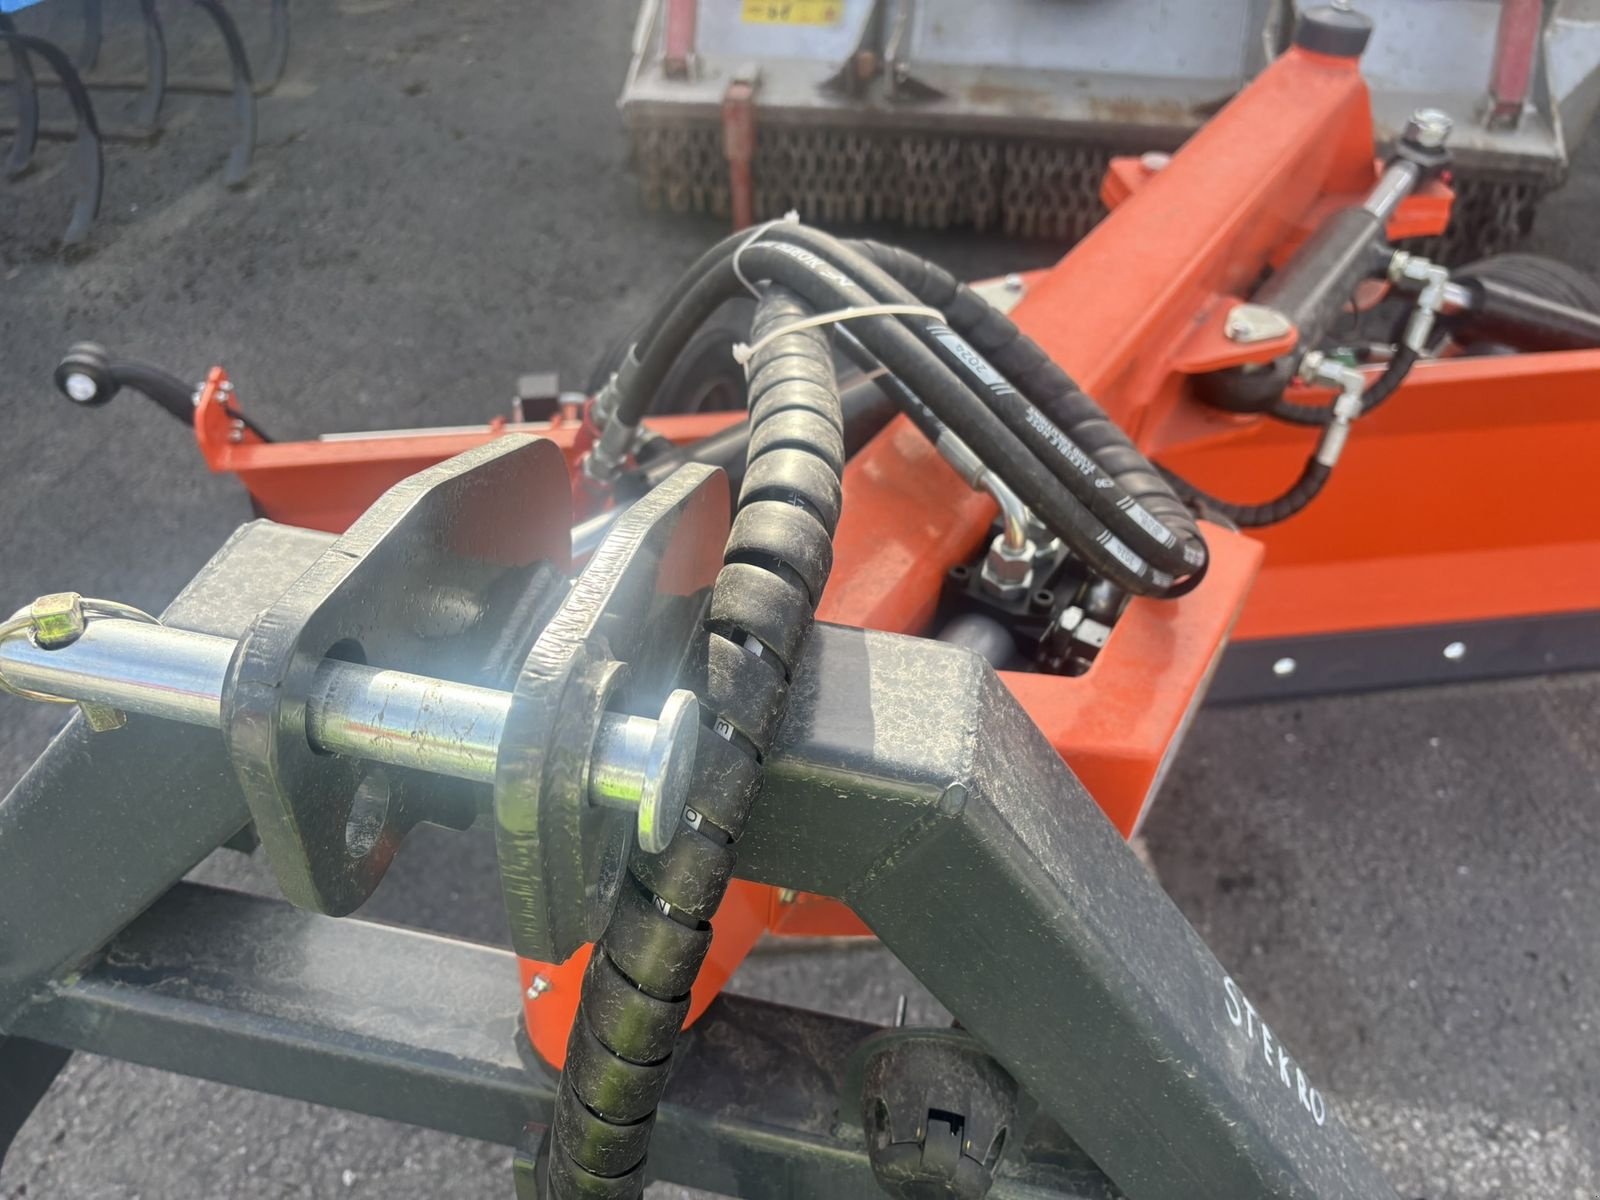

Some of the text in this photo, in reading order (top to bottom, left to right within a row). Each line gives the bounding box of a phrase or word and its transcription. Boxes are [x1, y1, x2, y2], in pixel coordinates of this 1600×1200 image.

[955, 343, 987, 374] 2024
[1025, 413, 1090, 475] FLEXIBLE HOSE
[1223, 976, 1325, 1126] STEKRO
